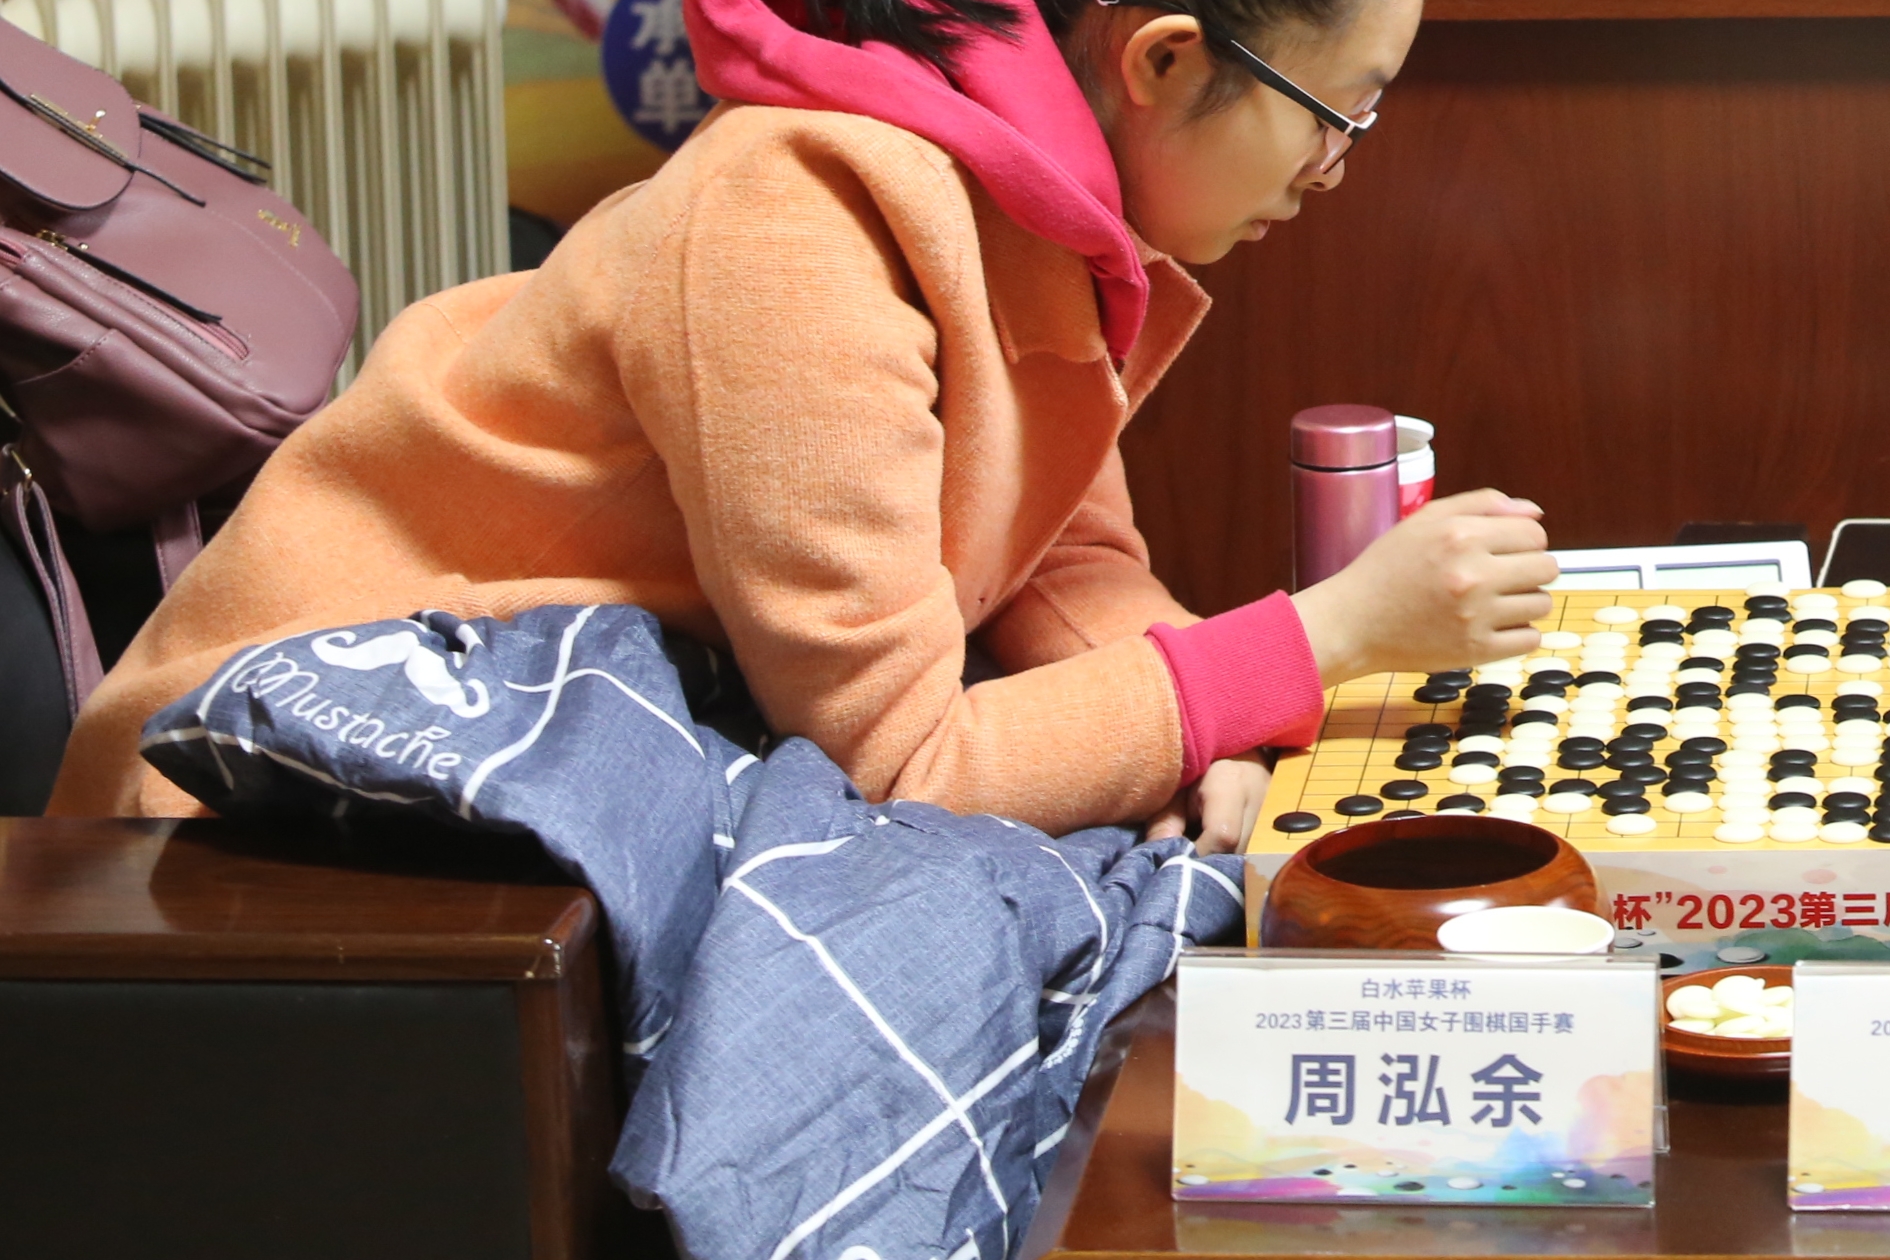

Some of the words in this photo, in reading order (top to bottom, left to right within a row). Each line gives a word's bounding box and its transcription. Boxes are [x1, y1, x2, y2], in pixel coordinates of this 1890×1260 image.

[1360, 977, 1472, 1001] 白水苹果杯
[1255, 1009, 1575, 1034] 2023第三届中国女子围棋国手赛
[1284, 1053, 1544, 1127] 周泓余
